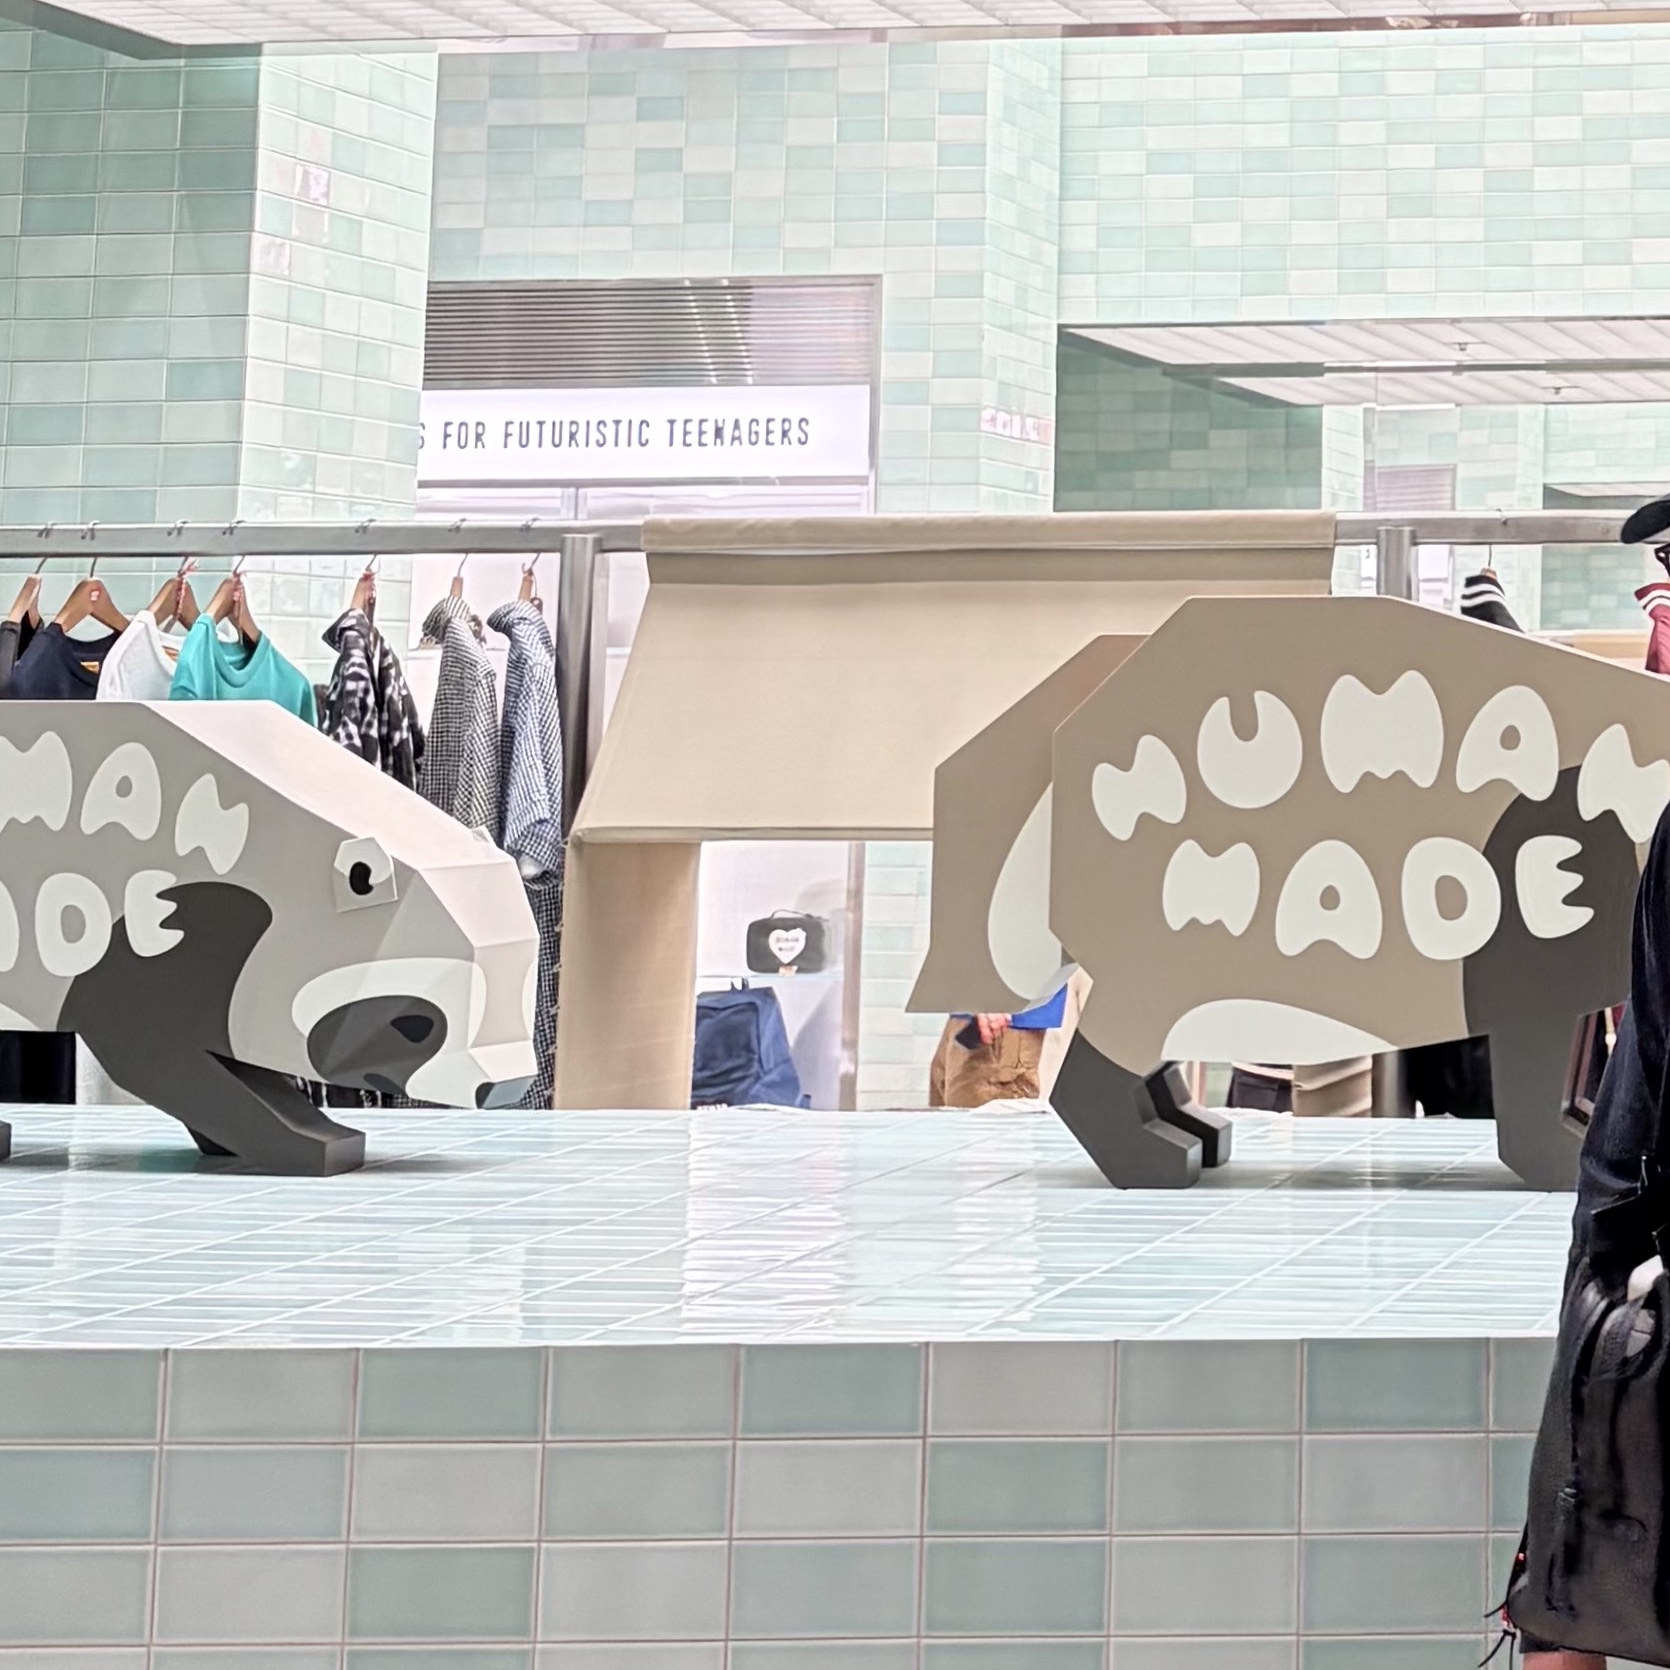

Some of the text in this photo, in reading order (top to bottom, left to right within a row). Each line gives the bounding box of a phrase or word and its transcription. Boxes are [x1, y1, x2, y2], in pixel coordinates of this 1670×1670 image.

[442, 421, 486, 450] FOR
[503, 419, 650, 449] FUTURISTIC
[667, 417, 810, 447] TEENAGERS
[0, 869, 185, 977] DE
[1162, 836, 1595, 961] MADE
